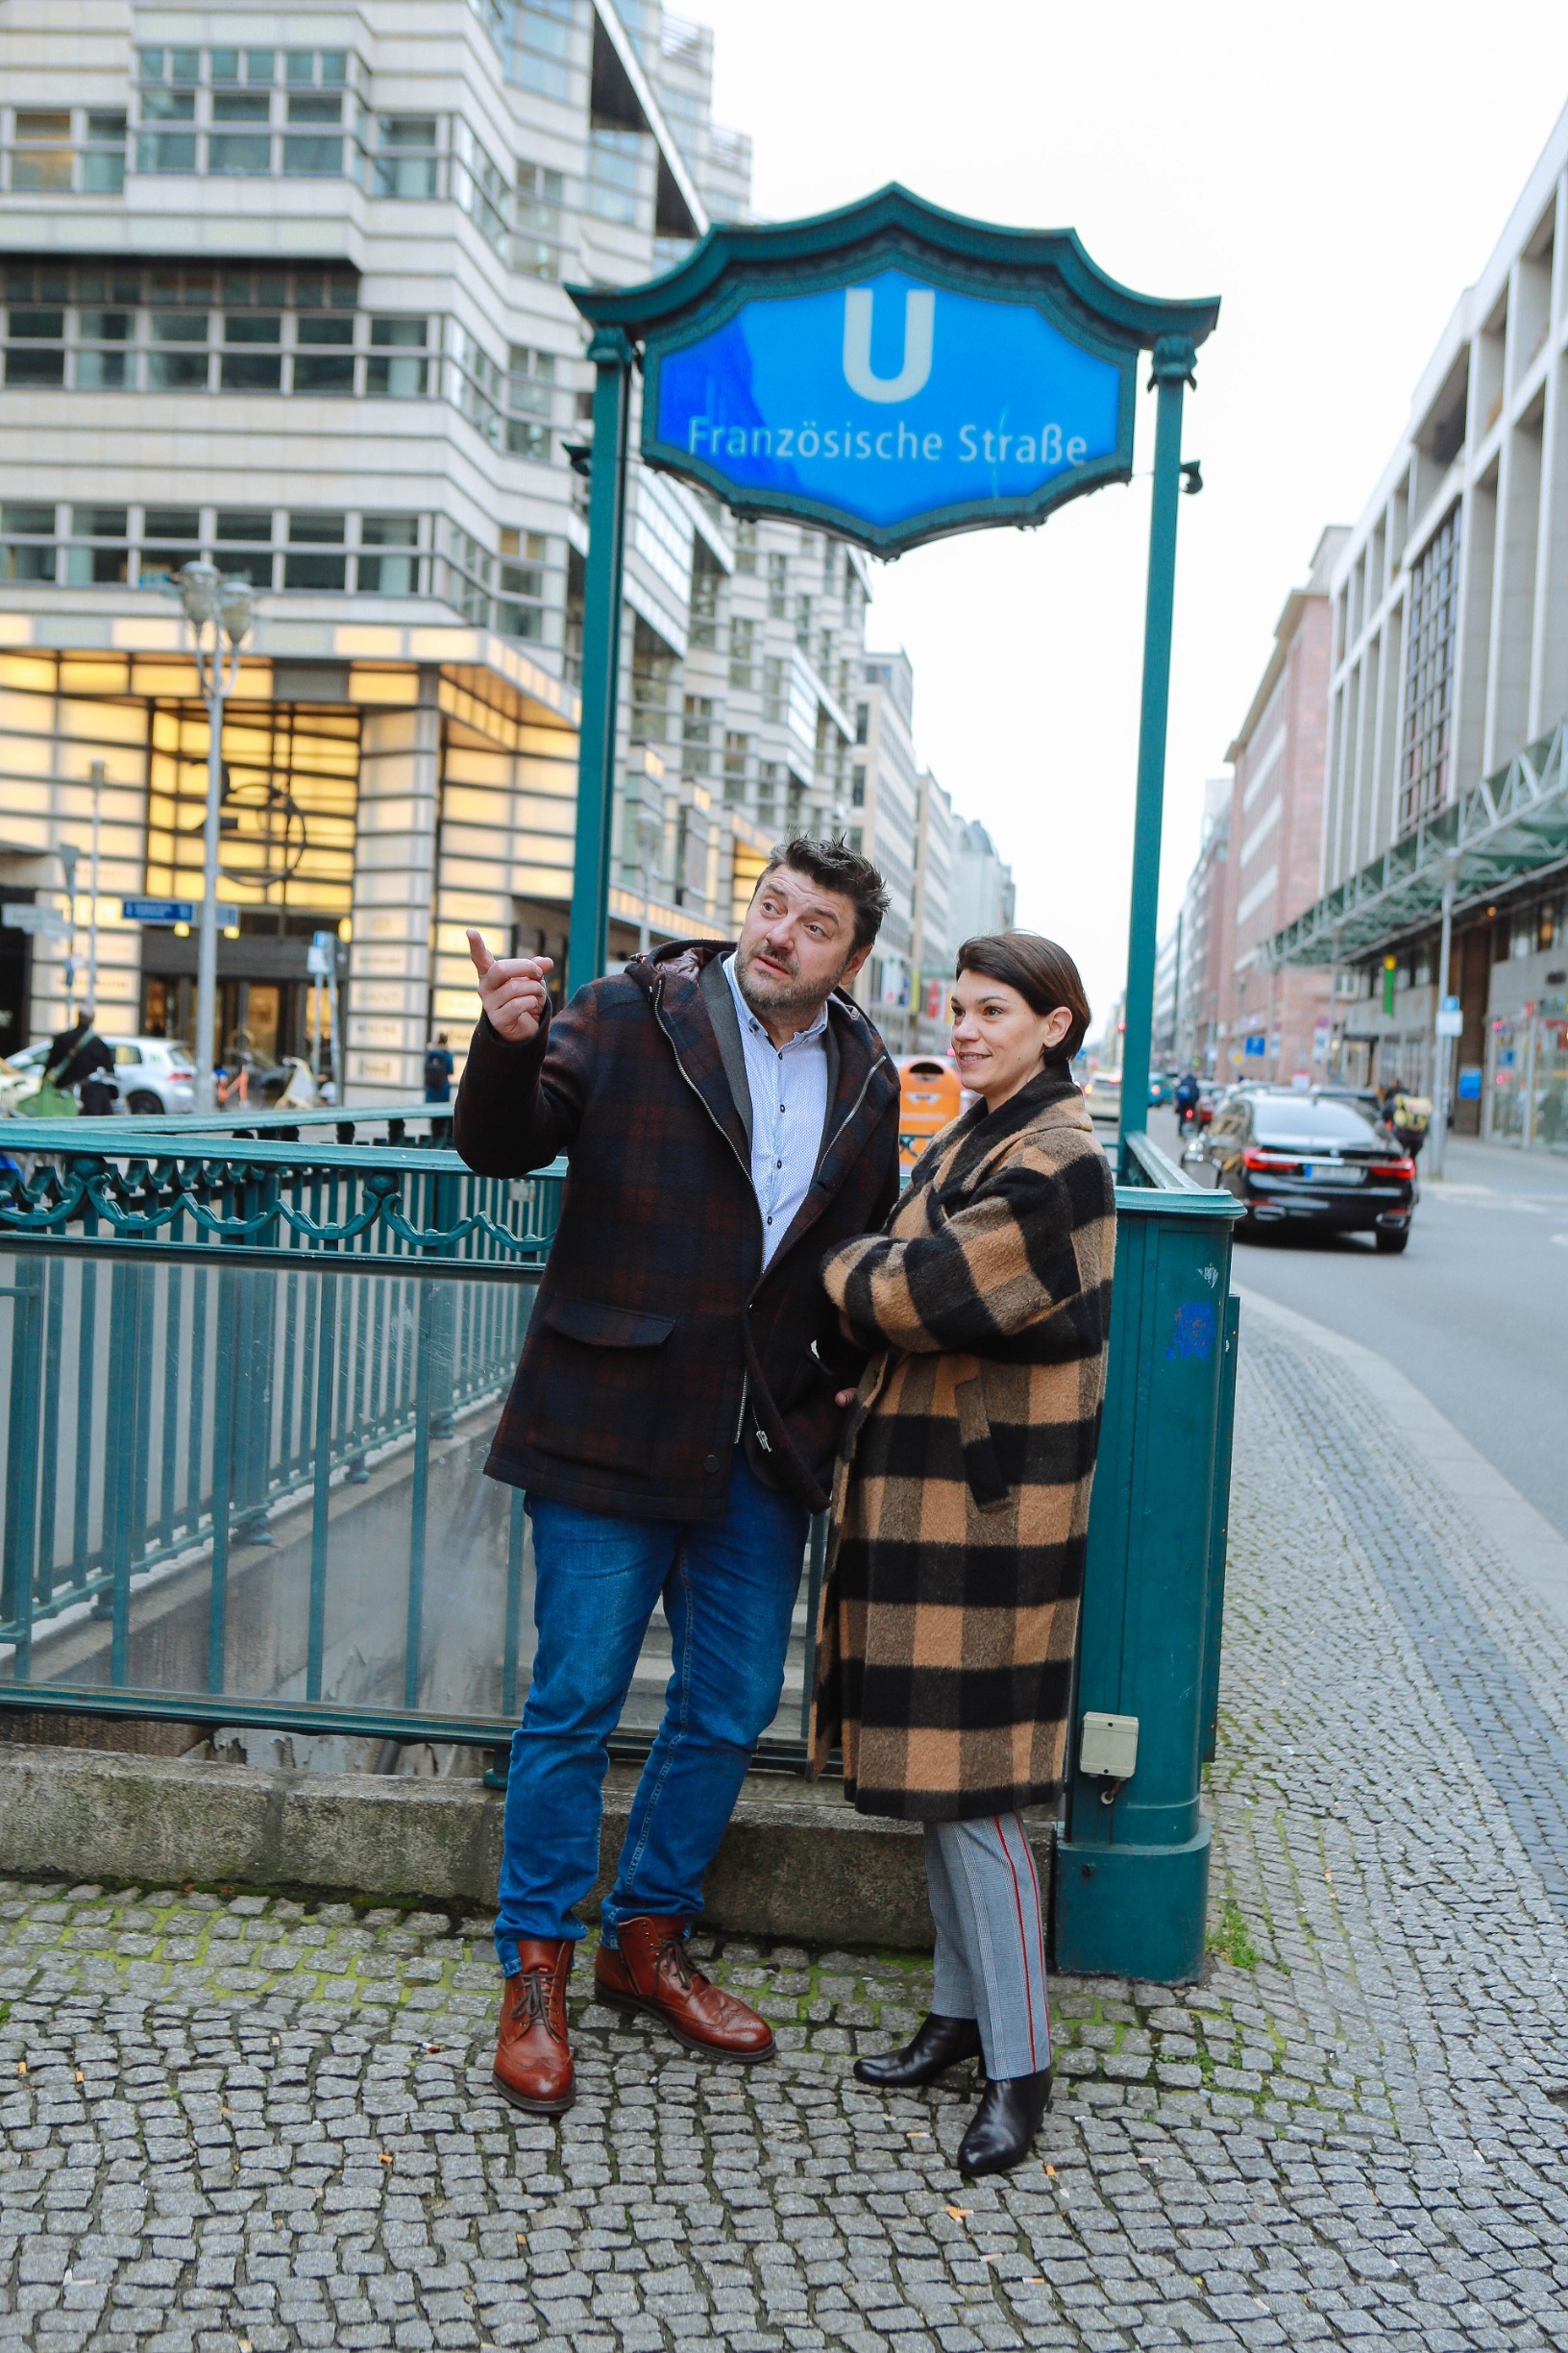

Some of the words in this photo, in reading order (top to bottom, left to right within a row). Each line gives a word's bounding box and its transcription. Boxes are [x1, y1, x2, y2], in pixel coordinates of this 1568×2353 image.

[843, 287, 936, 404] U
[688, 416, 943, 461] Französische
[959, 423, 1088, 467] Straße
